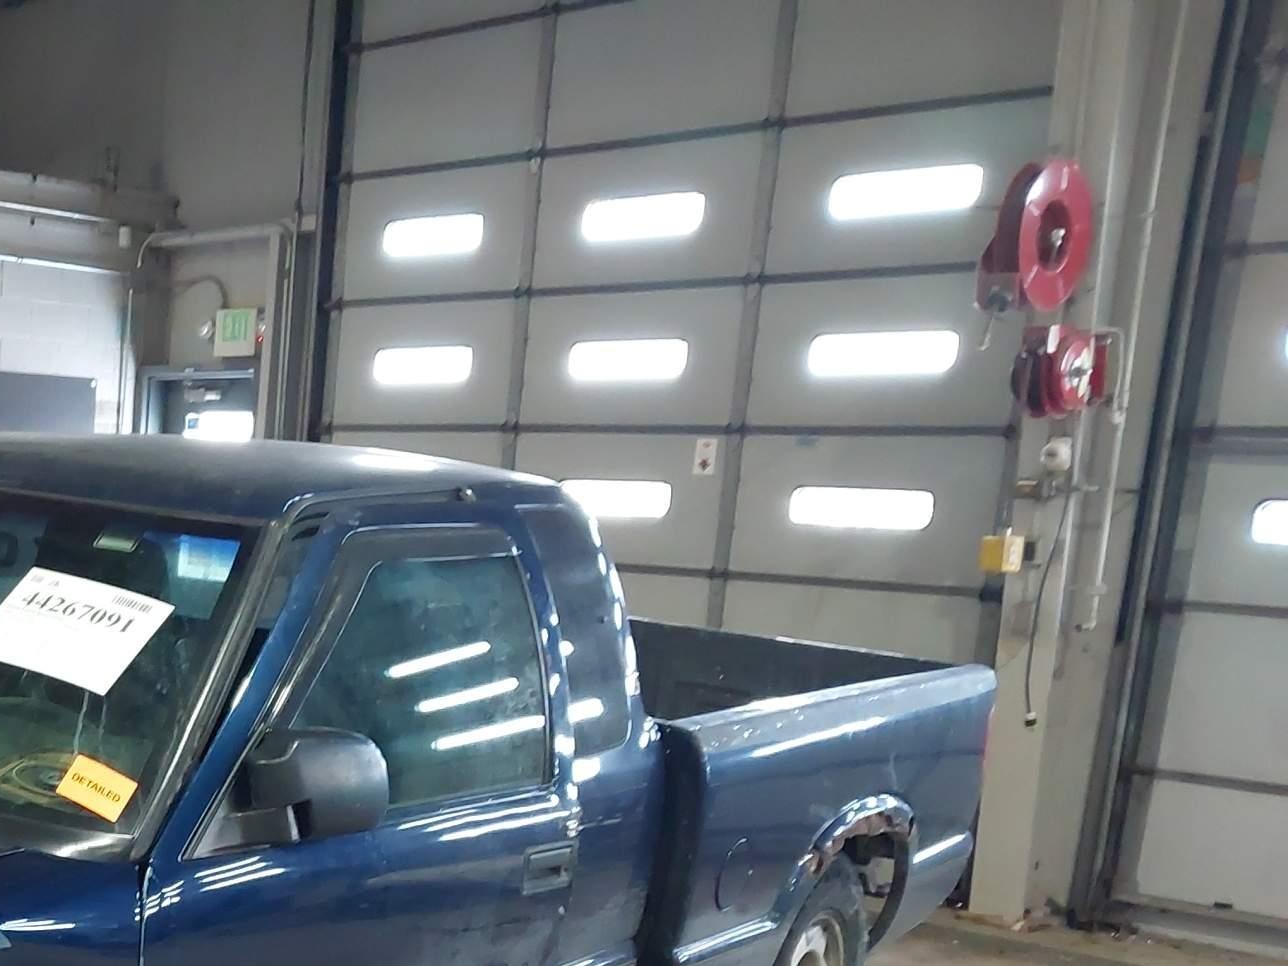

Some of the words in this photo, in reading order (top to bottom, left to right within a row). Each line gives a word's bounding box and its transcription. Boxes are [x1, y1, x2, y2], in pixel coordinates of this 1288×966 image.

[223, 310, 249, 341] EXIT
[22, 591, 136, 633] 44267091
[71, 772, 121, 803] DETAILED
